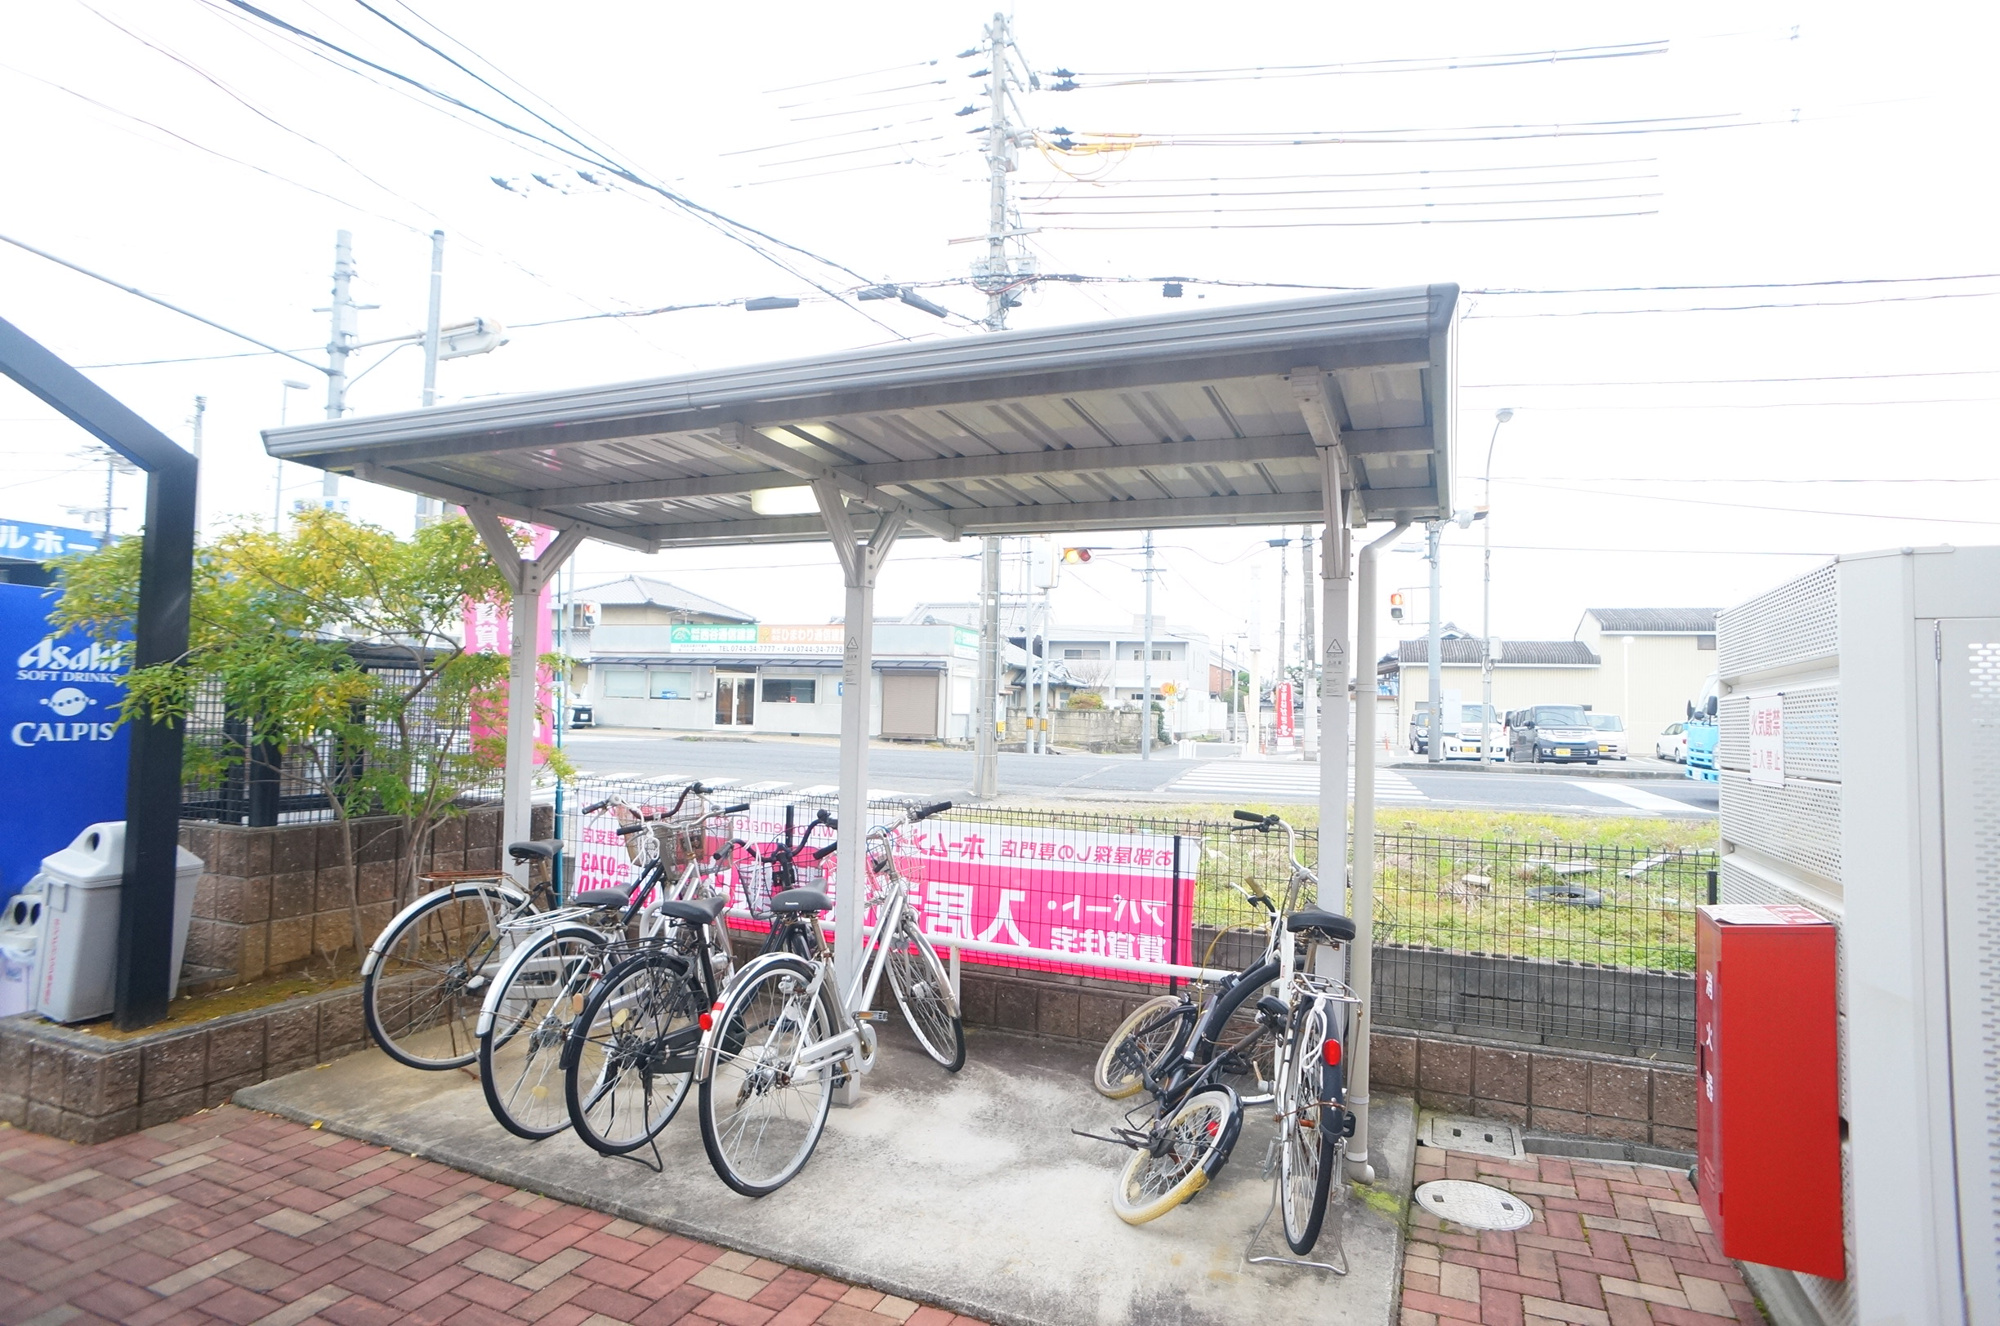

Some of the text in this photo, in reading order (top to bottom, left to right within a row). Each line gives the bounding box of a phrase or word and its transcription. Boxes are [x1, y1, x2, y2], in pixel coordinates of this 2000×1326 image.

[17, 639, 122, 672] Asahi
[16, 669, 120, 684] SOFT DRINKS
[11, 721, 115, 747] CALPIS
[1751, 708, 1780, 737] 火気厳禁
